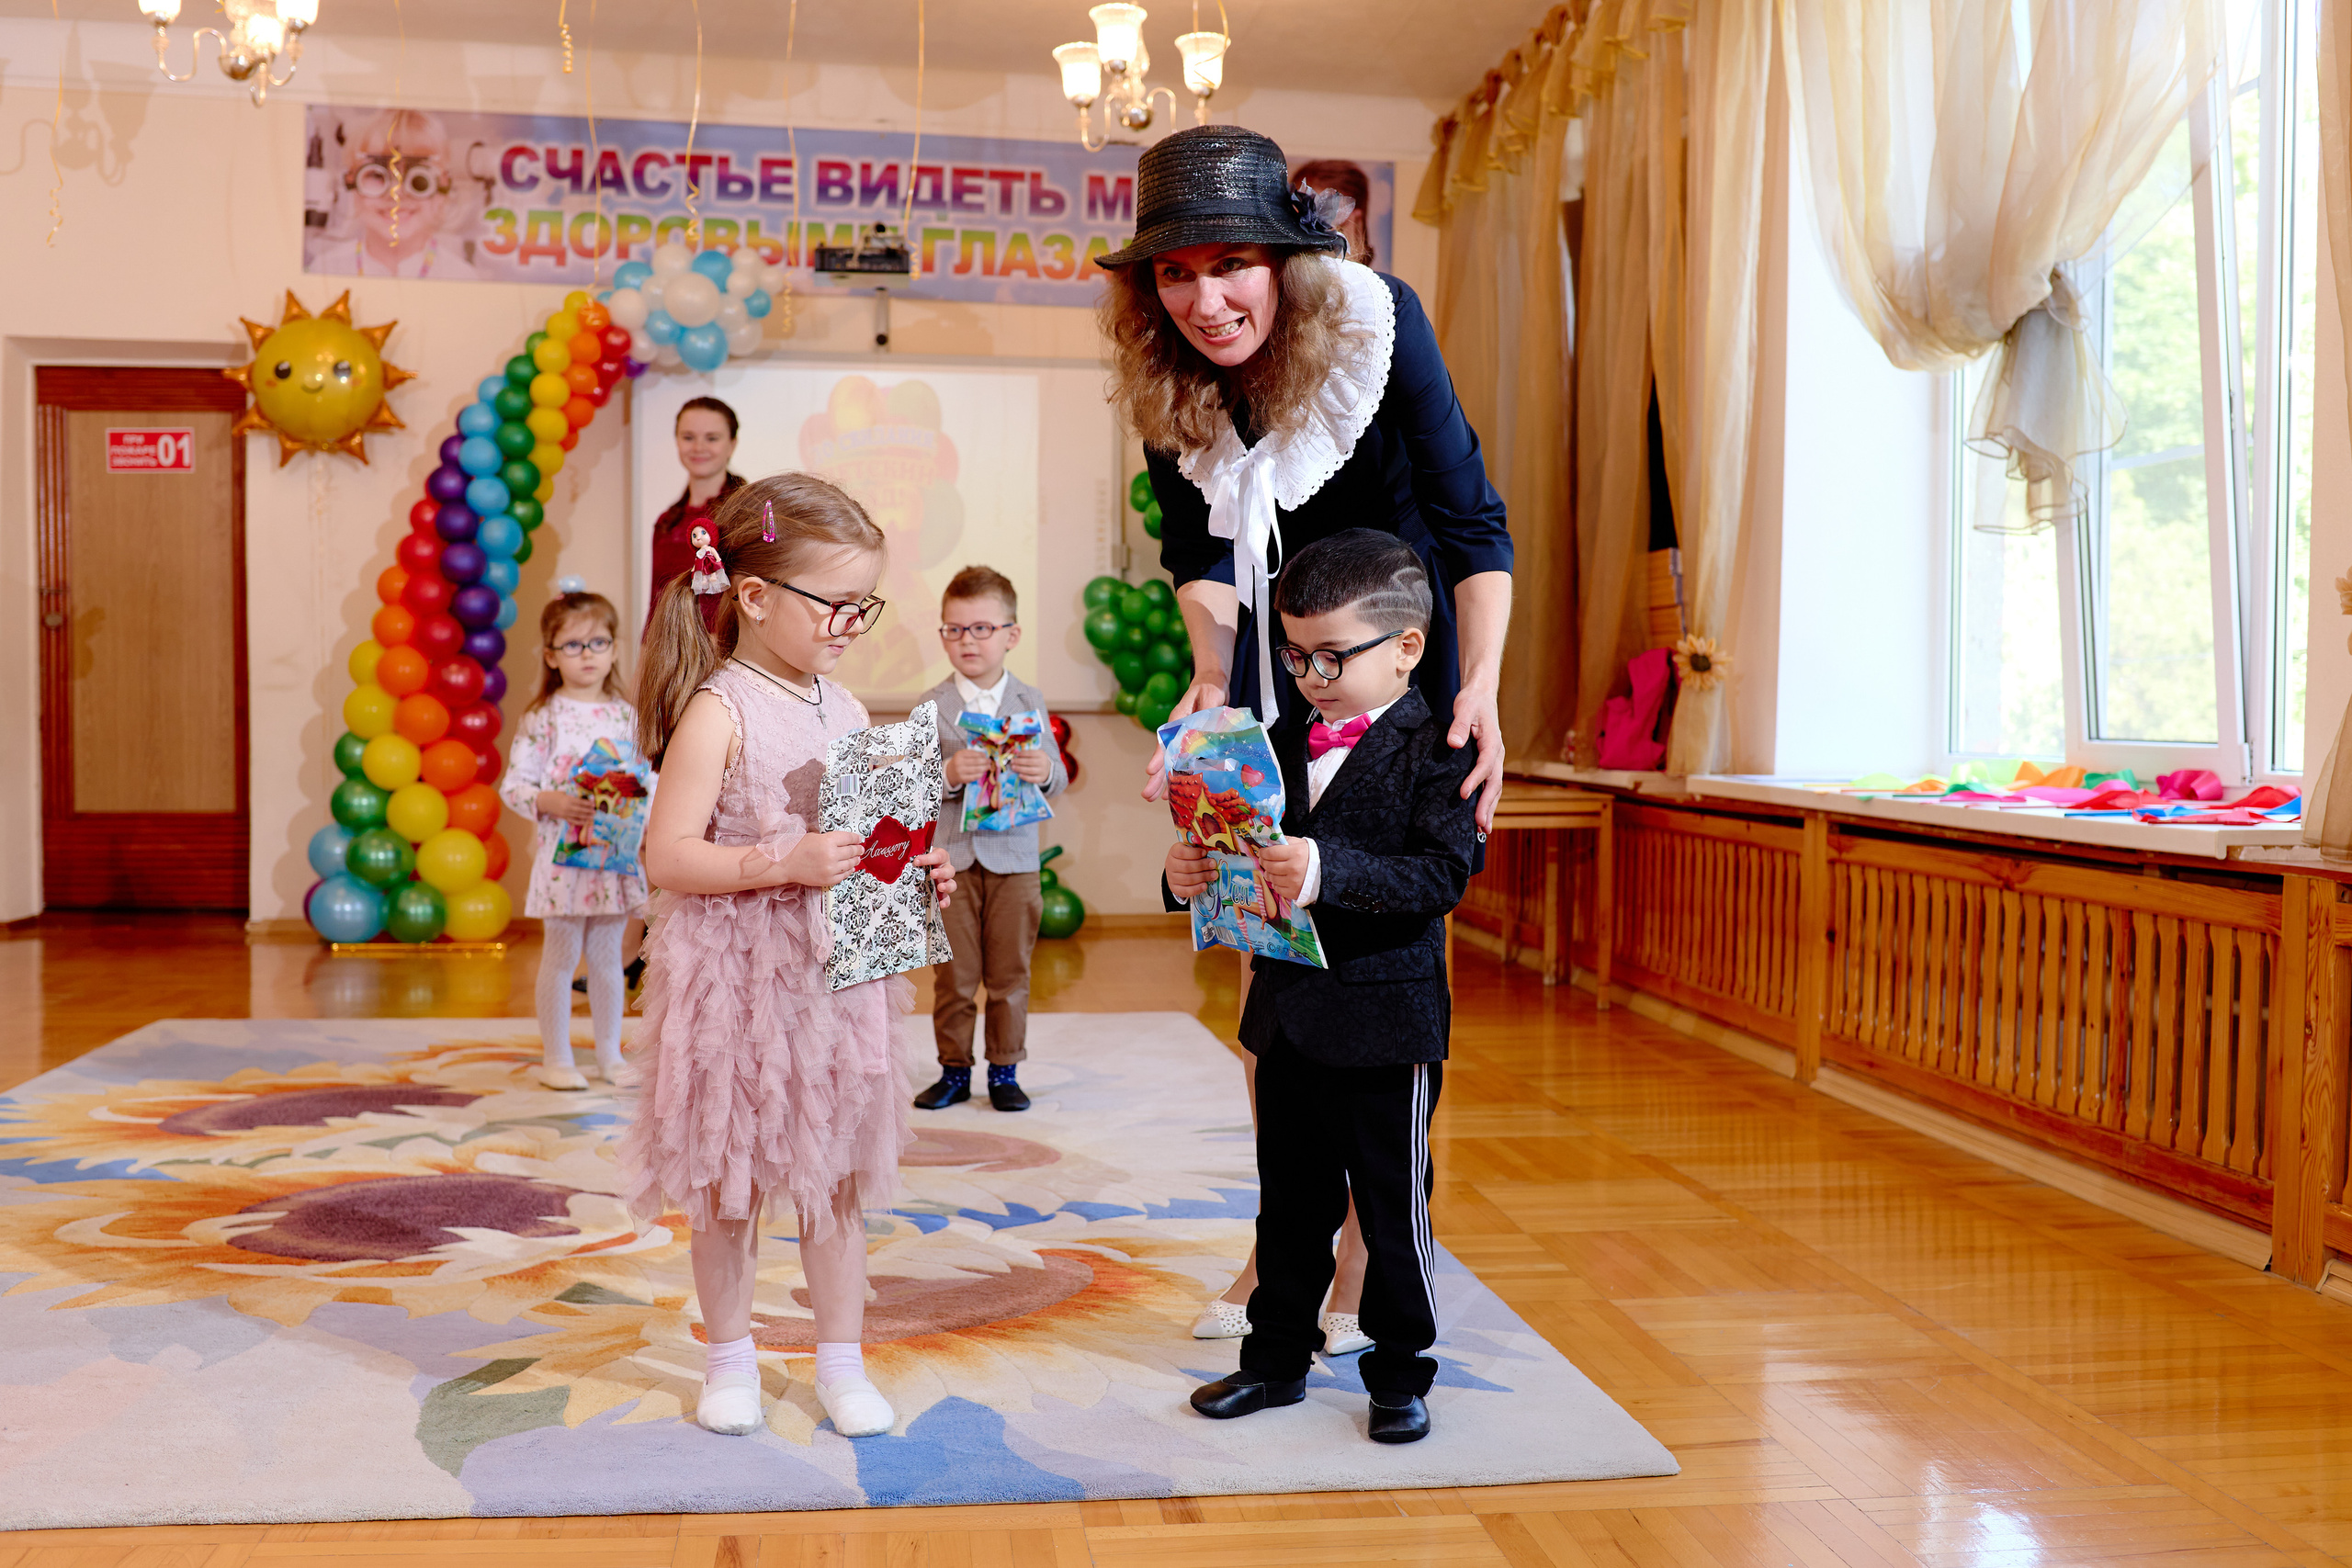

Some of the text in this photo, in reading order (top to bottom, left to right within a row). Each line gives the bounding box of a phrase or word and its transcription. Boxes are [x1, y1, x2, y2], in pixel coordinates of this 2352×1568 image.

[500, 145, 797, 203] СЧАСТЬЕ
[817, 160, 1067, 221] ВИДЕТЬ
[482, 208, 1133, 280] ЗДОРОВЫМ ГЛАЗА
[157, 434, 190, 467] 01
[860, 840, 910, 860] Accessory
